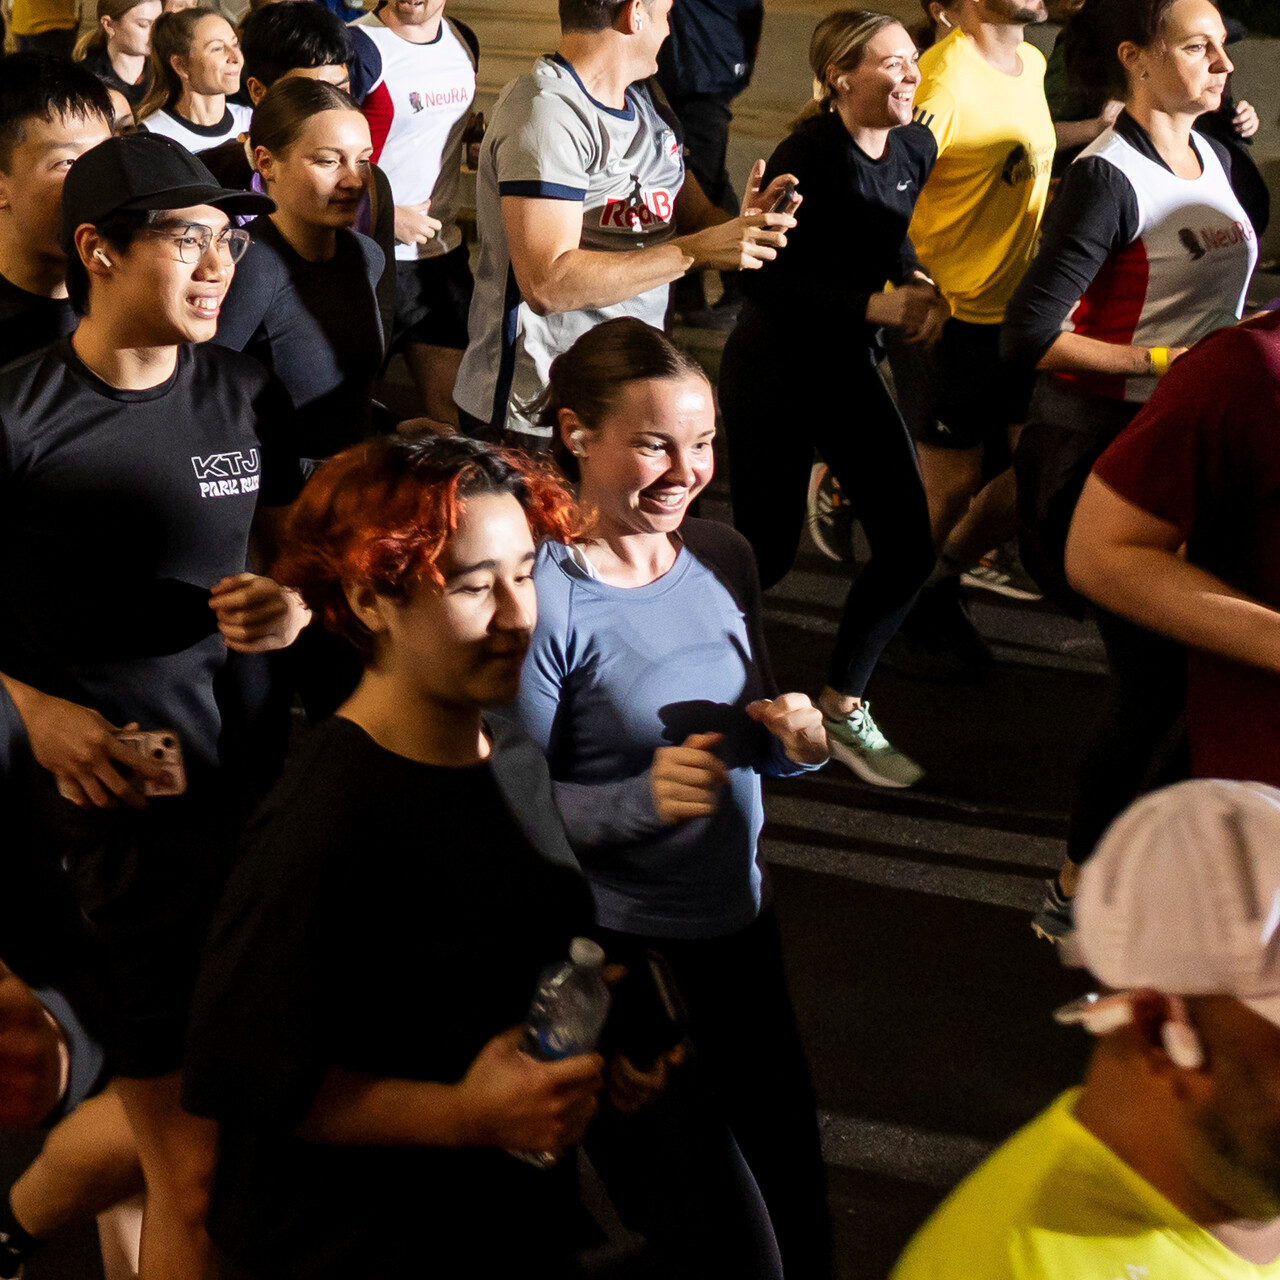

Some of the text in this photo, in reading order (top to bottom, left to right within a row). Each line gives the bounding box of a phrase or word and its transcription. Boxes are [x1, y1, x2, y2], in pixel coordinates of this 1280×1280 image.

[425, 86, 468, 109] NeuRA
[191, 448, 259, 480] KTJ
[199, 478, 240, 498] PARK
